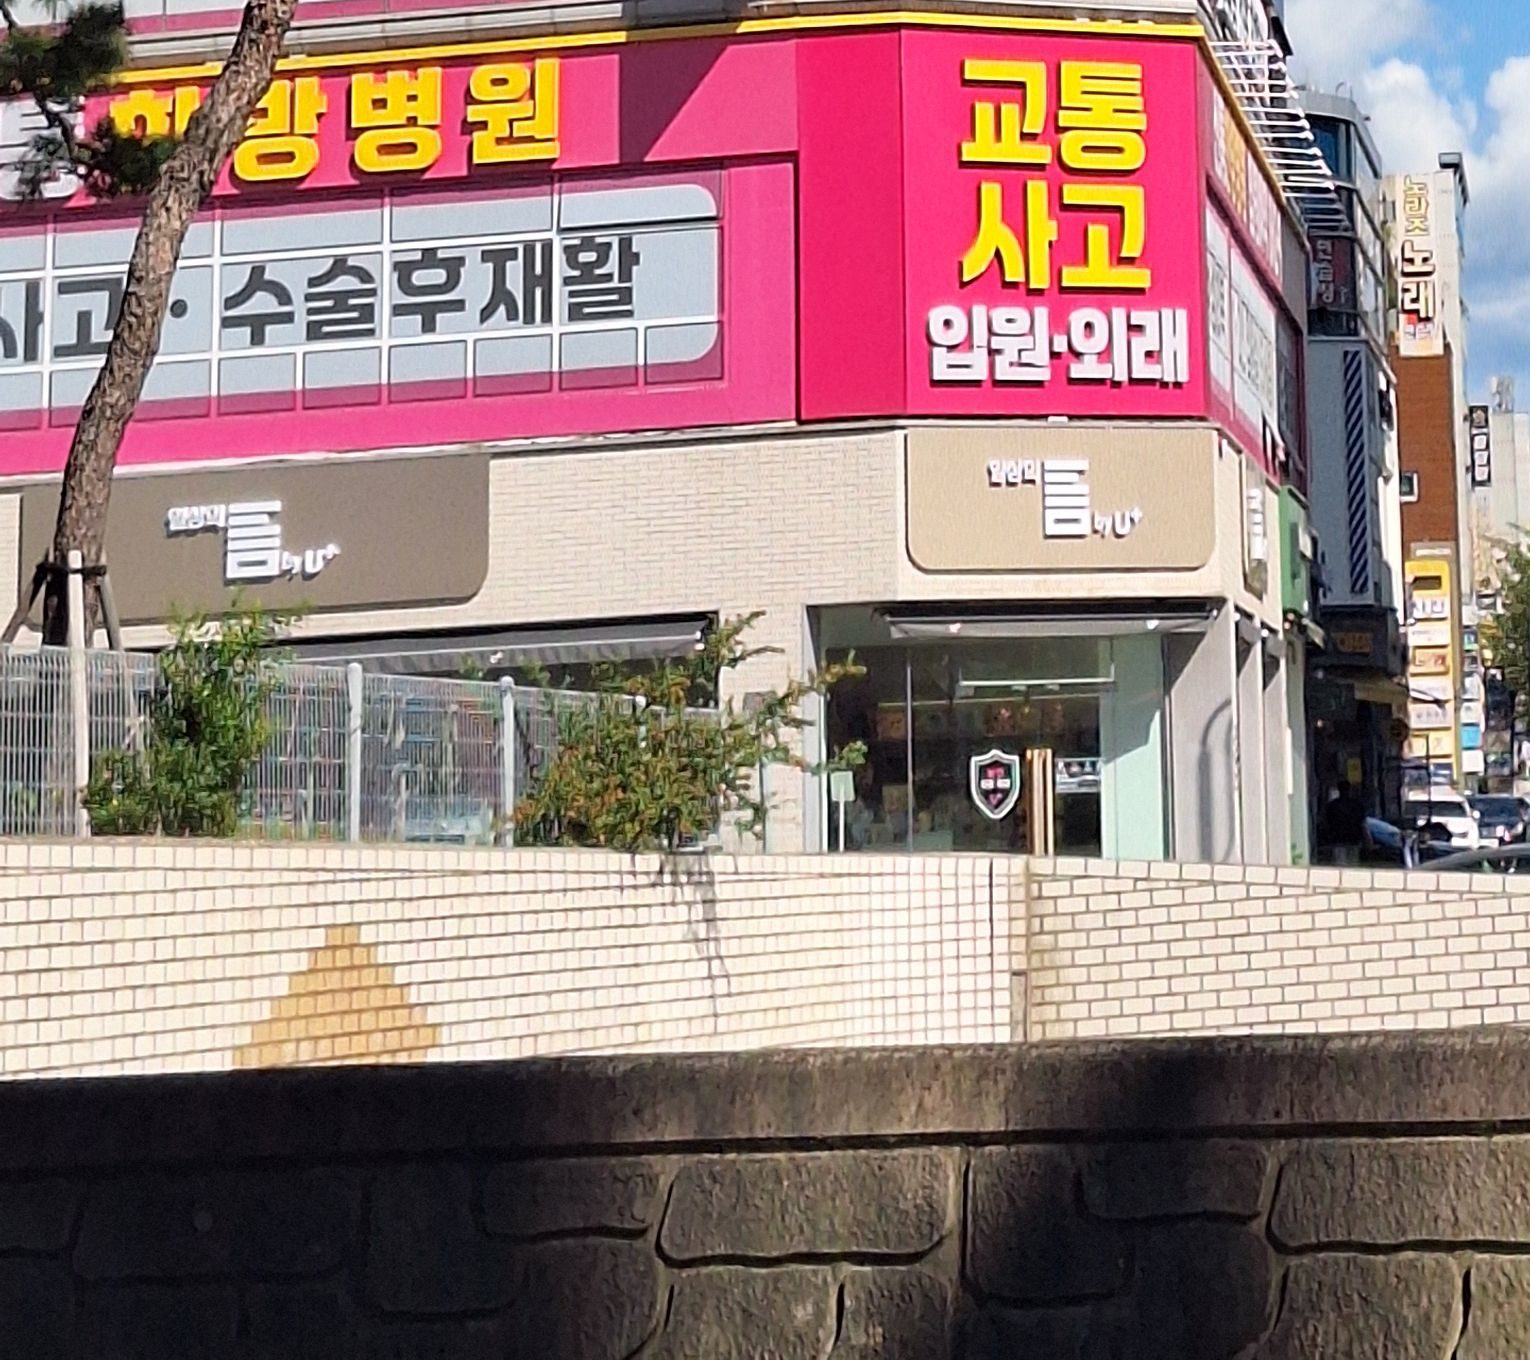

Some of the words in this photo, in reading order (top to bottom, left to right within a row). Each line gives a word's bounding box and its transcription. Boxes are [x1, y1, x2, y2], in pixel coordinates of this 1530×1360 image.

[960, 58, 1148, 172] 교통
[961, 180, 1152, 290] 사고
[1400, 240, 1436, 320] 노래
[928, 304, 1190, 384] 입원·외래
